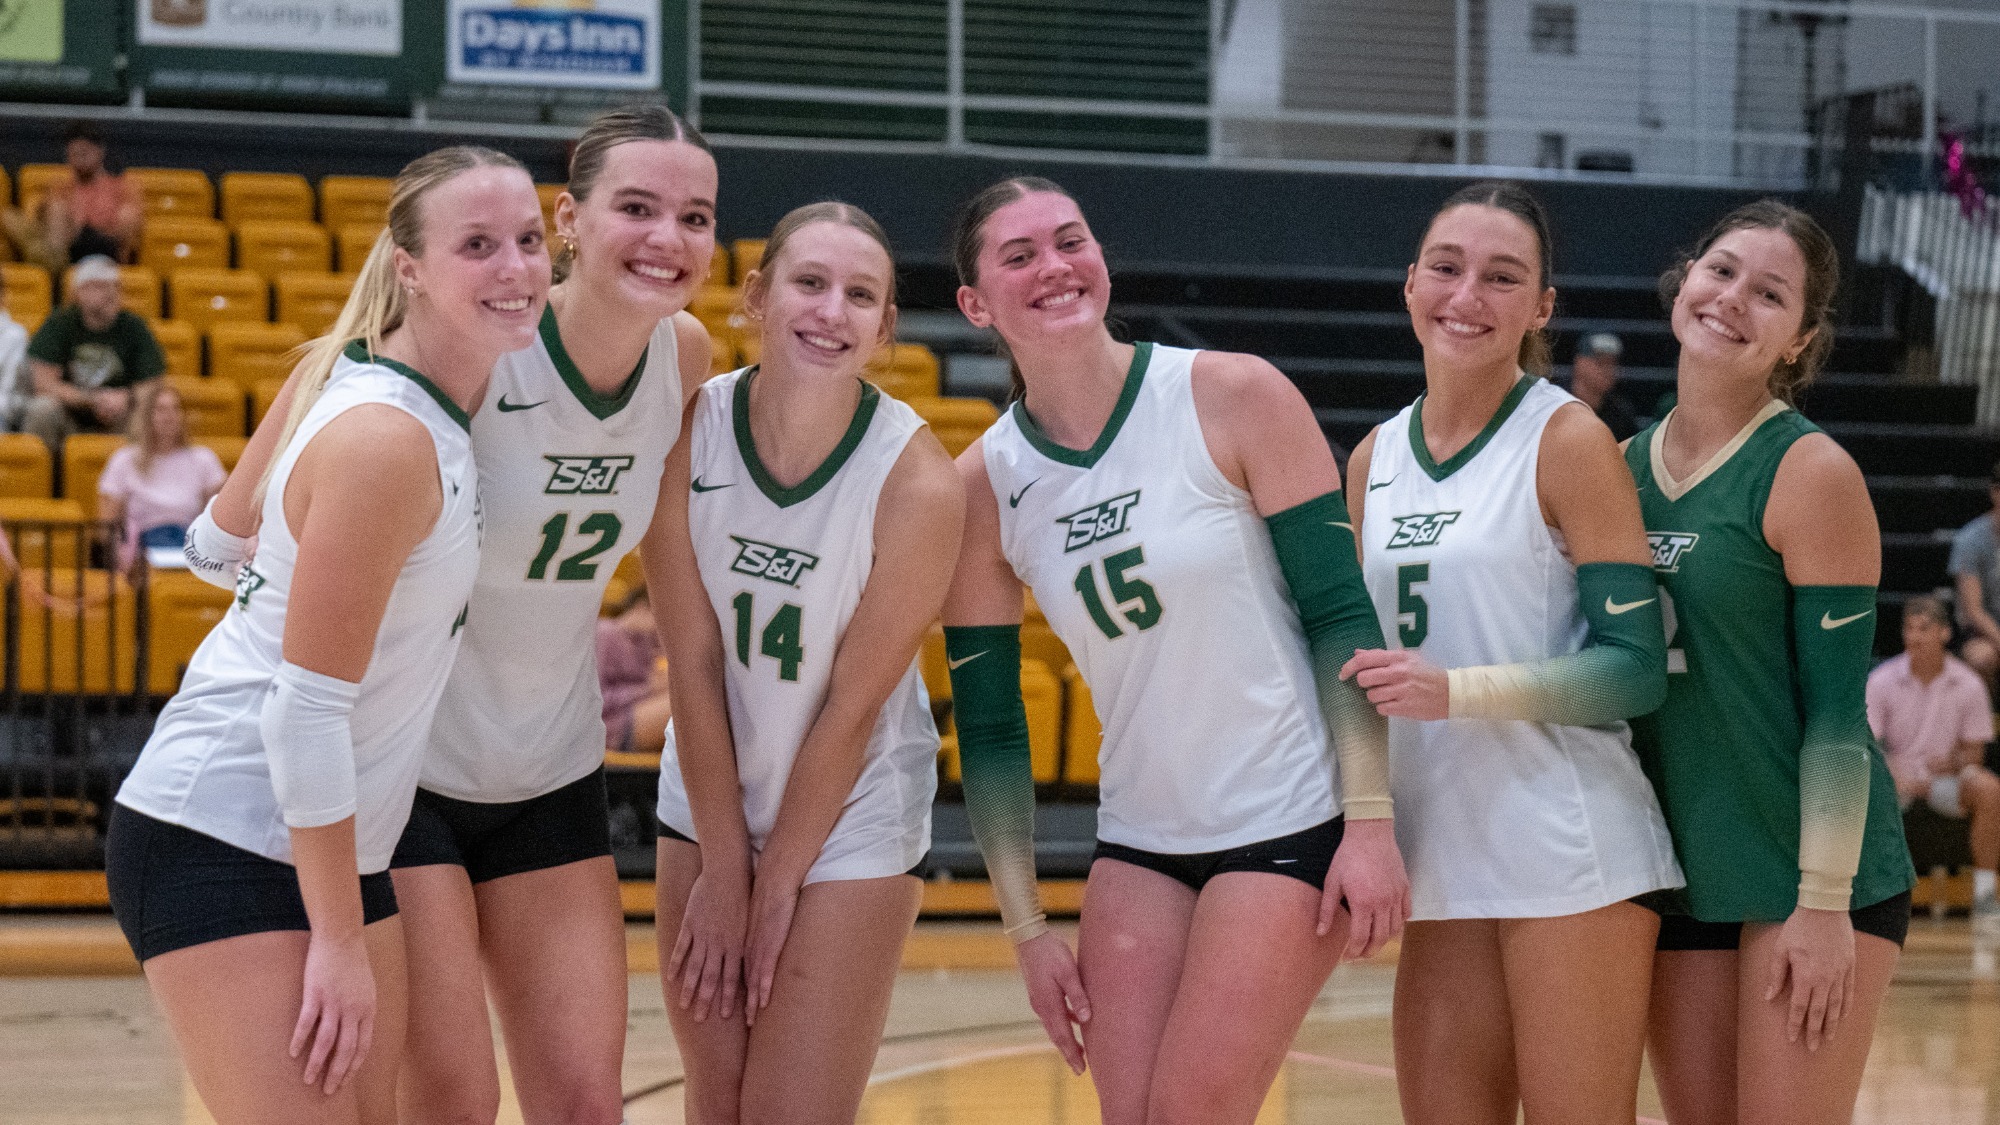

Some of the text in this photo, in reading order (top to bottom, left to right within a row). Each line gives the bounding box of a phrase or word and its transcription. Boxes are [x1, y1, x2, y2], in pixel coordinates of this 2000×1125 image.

[466, 14, 640, 55] Days Inn
[543, 454, 635, 494] S&T
[525, 510, 622, 581] 12
[1055, 489, 1141, 553] S&T
[1386, 510, 1462, 549] S&T
[730, 534, 820, 590] S&T
[1072, 542, 1164, 641] 15
[731, 589, 804, 683] 14
[1397, 560, 1430, 648] 5
